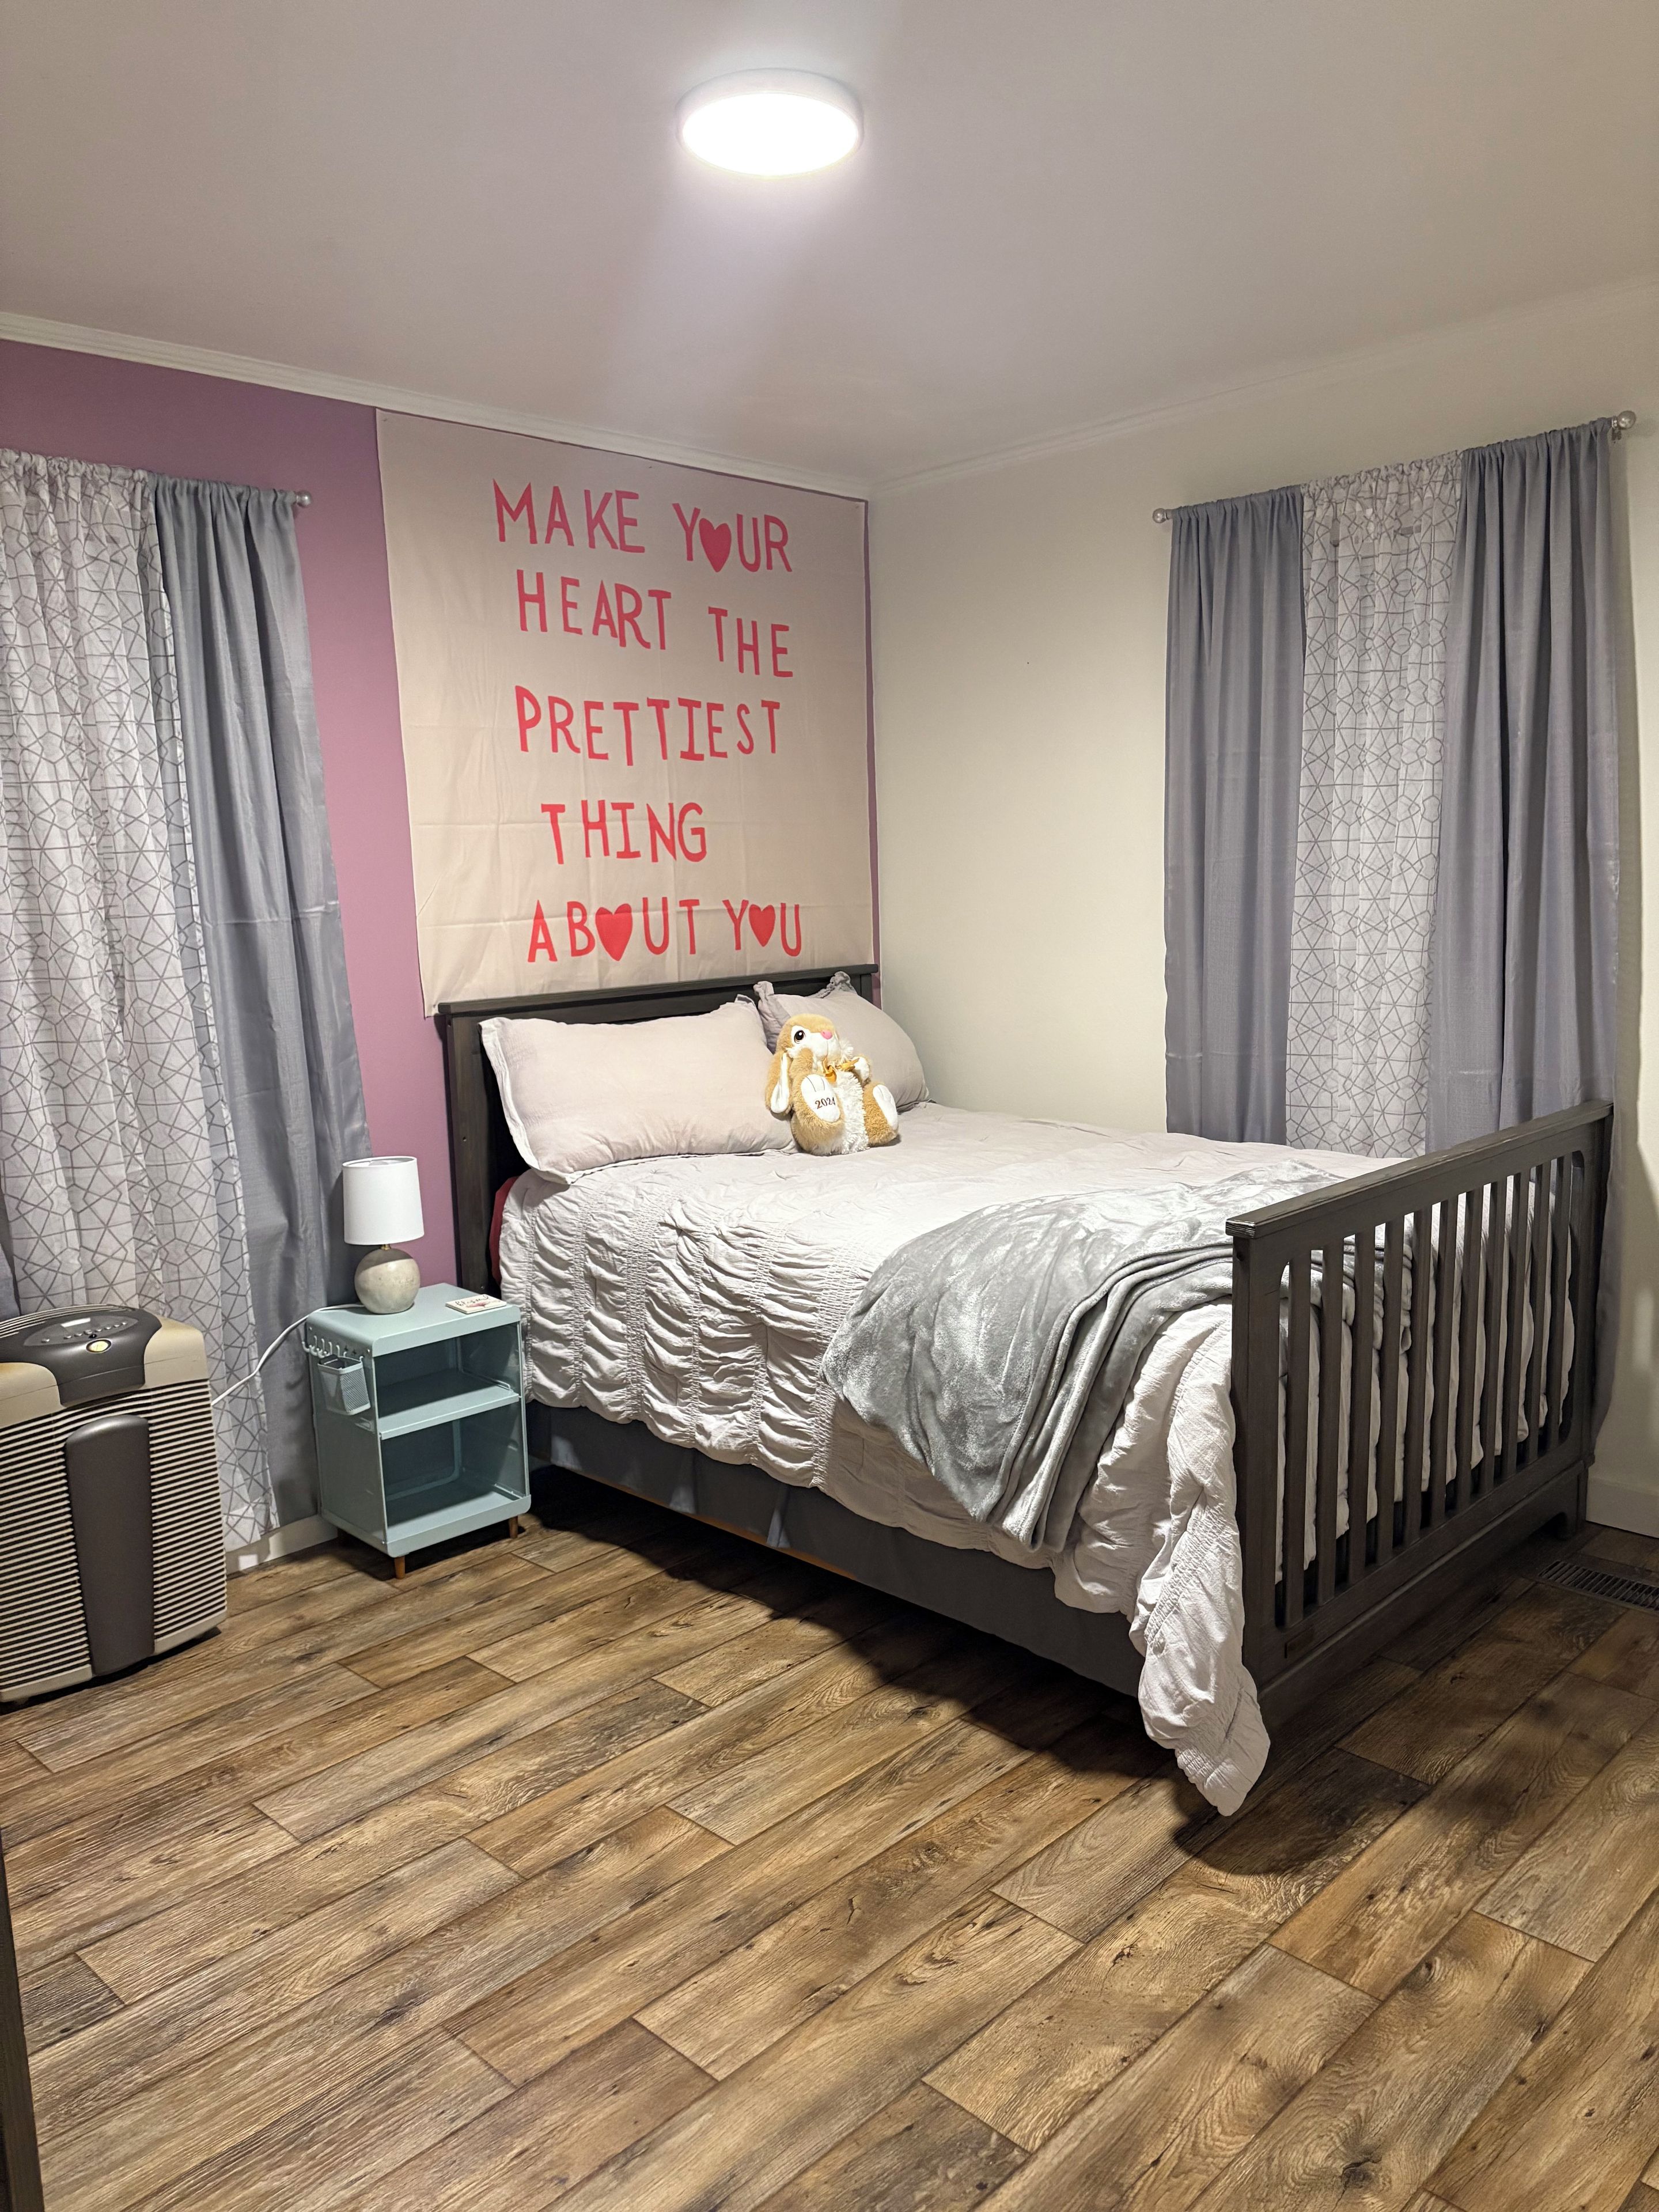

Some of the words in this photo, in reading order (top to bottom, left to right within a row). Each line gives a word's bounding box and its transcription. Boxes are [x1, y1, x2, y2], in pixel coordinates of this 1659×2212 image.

[492, 479, 645, 554] MAKE
[516, 569, 672, 651] HEART
[707, 606, 794, 679] THE
[514, 684, 781, 767] PRETTIEST
[540, 799, 707, 865] THING
